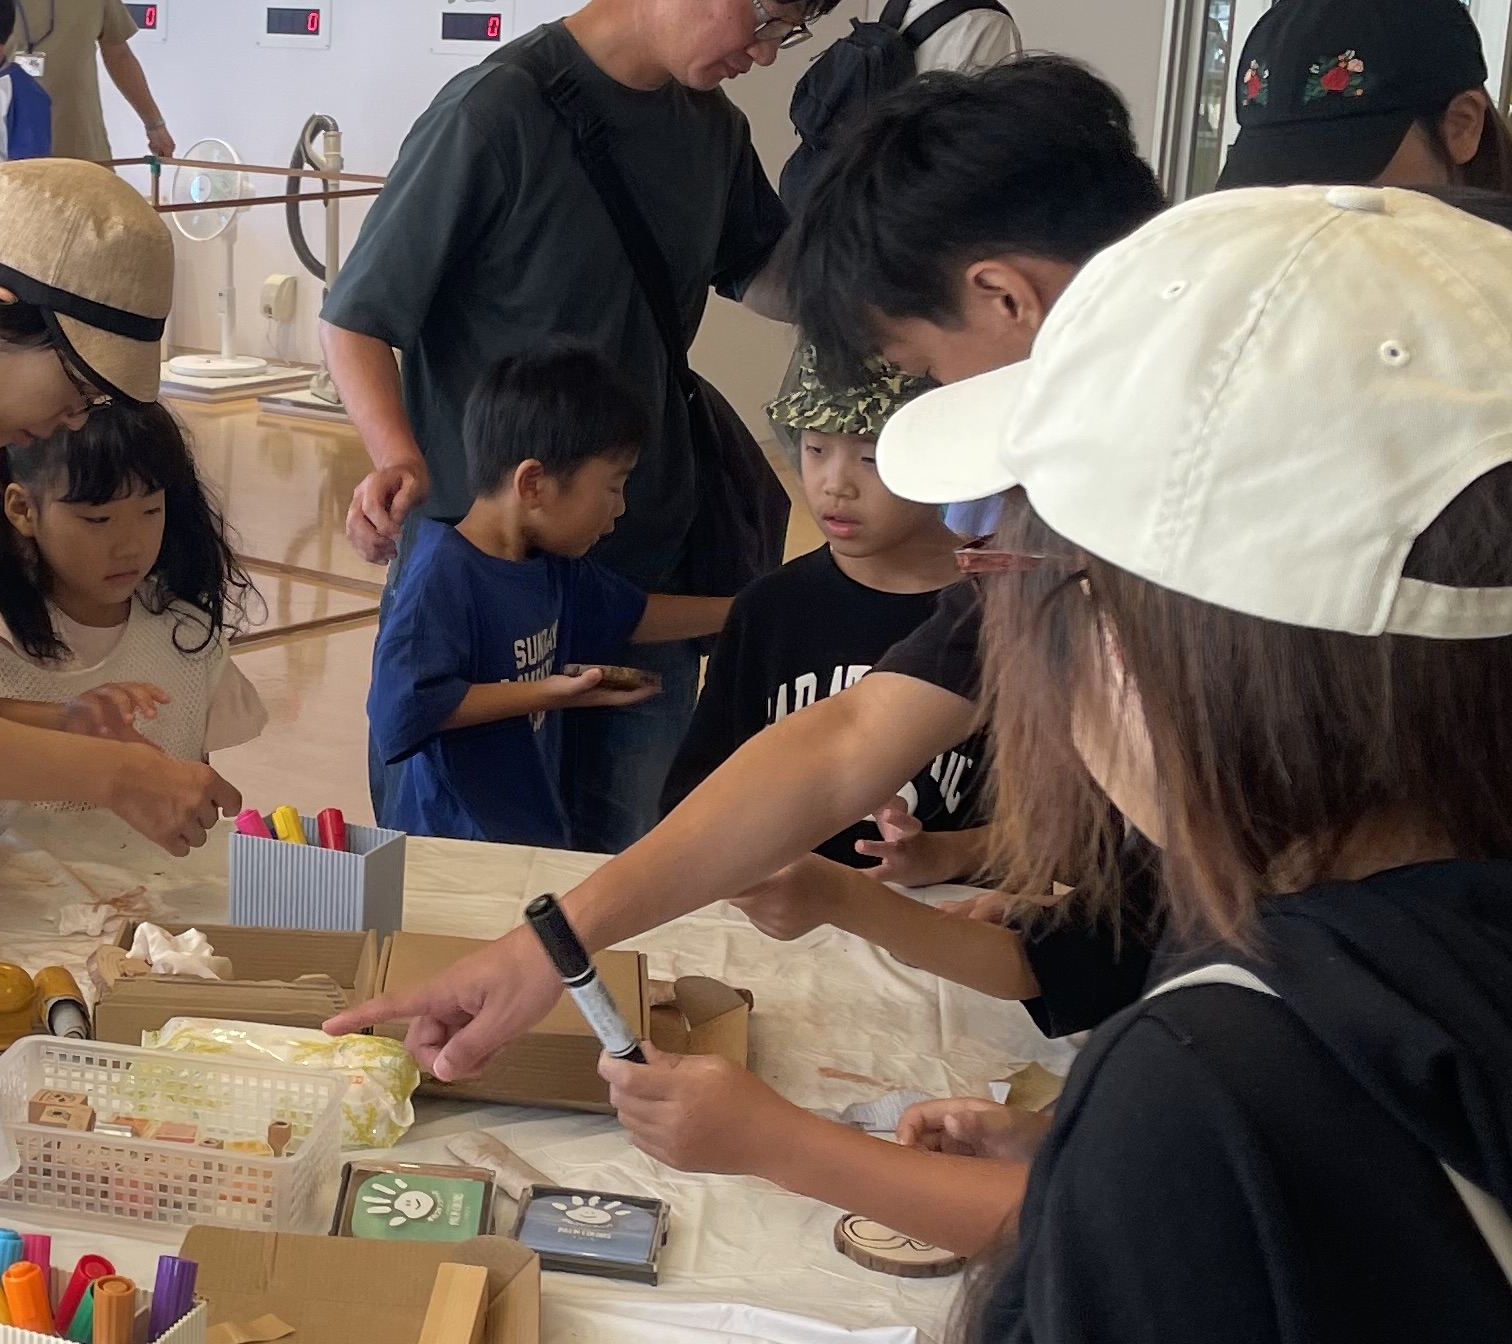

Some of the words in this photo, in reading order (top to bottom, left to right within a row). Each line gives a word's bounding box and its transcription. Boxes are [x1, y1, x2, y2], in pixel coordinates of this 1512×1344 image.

[145, 7, 156, 27] 0
[308, 12, 319, 31] 0
[487, 16, 500, 37] 0
